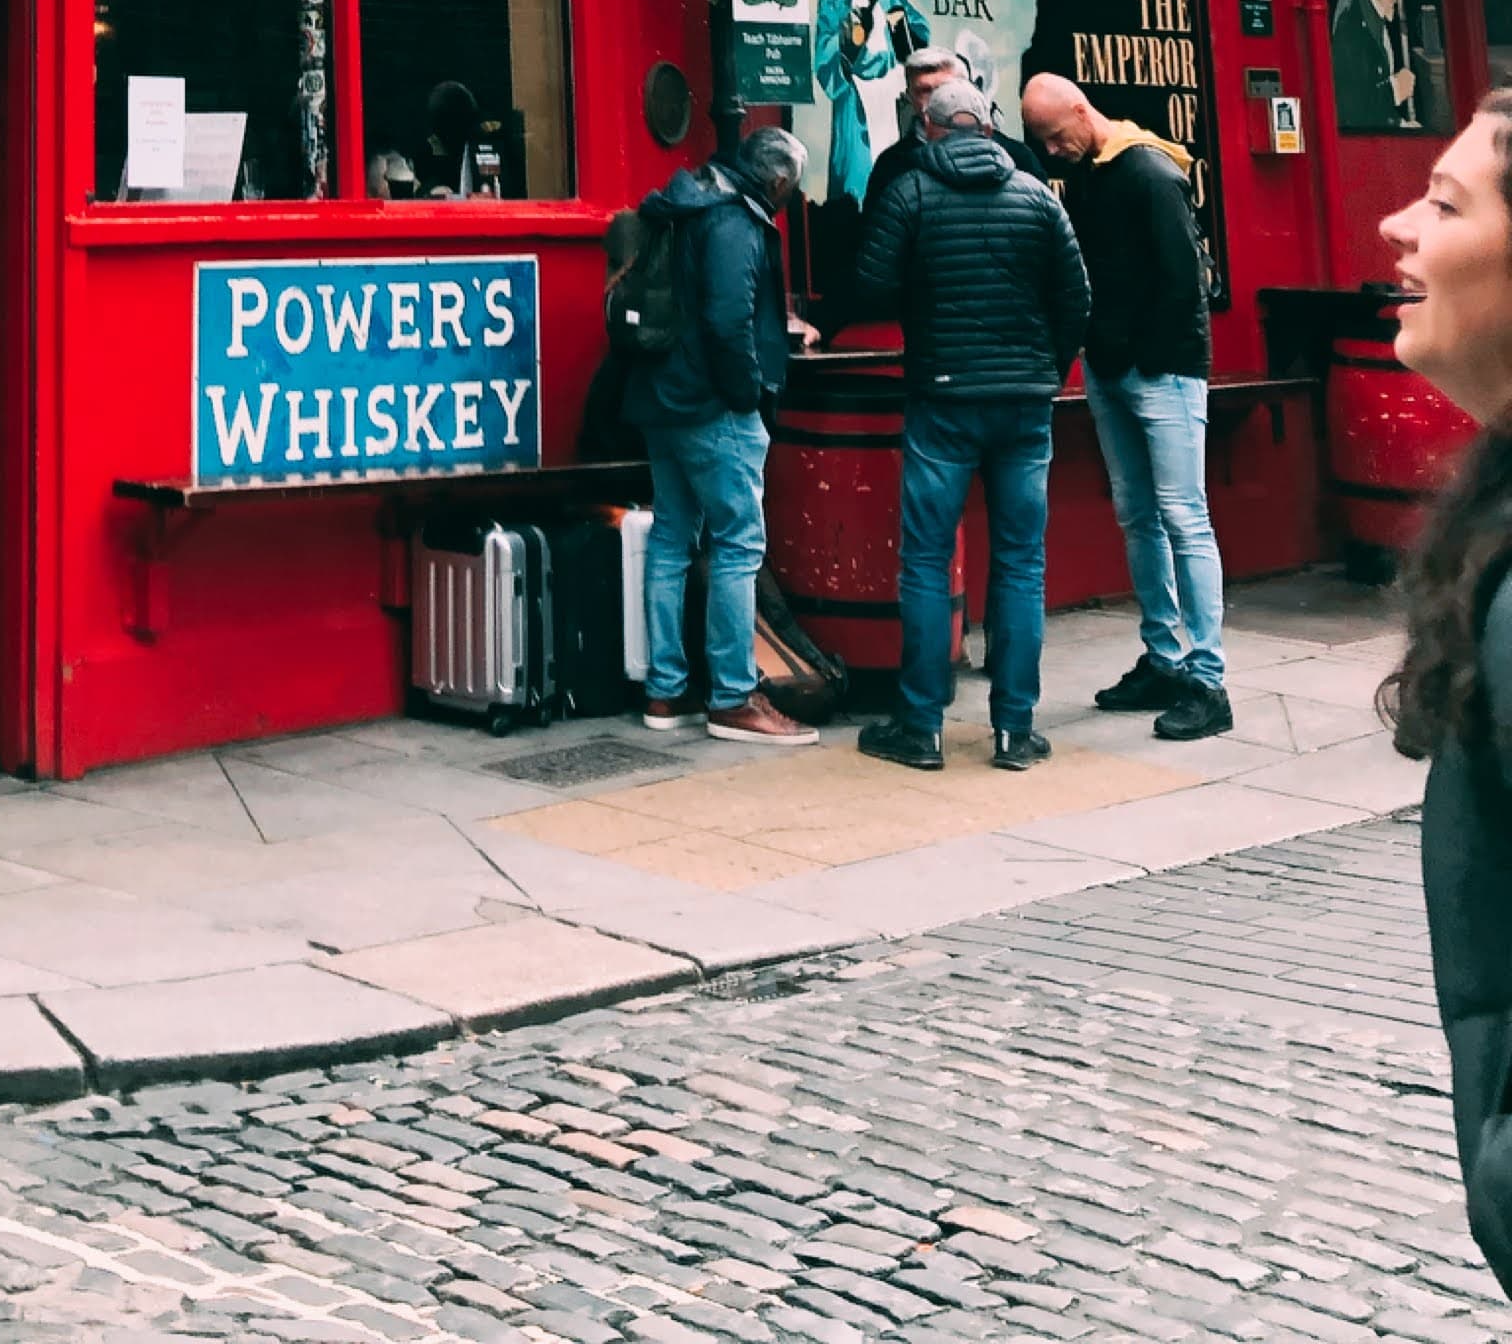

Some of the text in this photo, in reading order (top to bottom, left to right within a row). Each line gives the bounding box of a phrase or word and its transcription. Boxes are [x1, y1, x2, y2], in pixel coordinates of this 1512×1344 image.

[1072, 32, 1199, 90] EMPEROR
[1167, 93, 1199, 144] OF
[225, 276, 516, 358] POWER'S
[204, 377, 533, 467] WHISKEY
